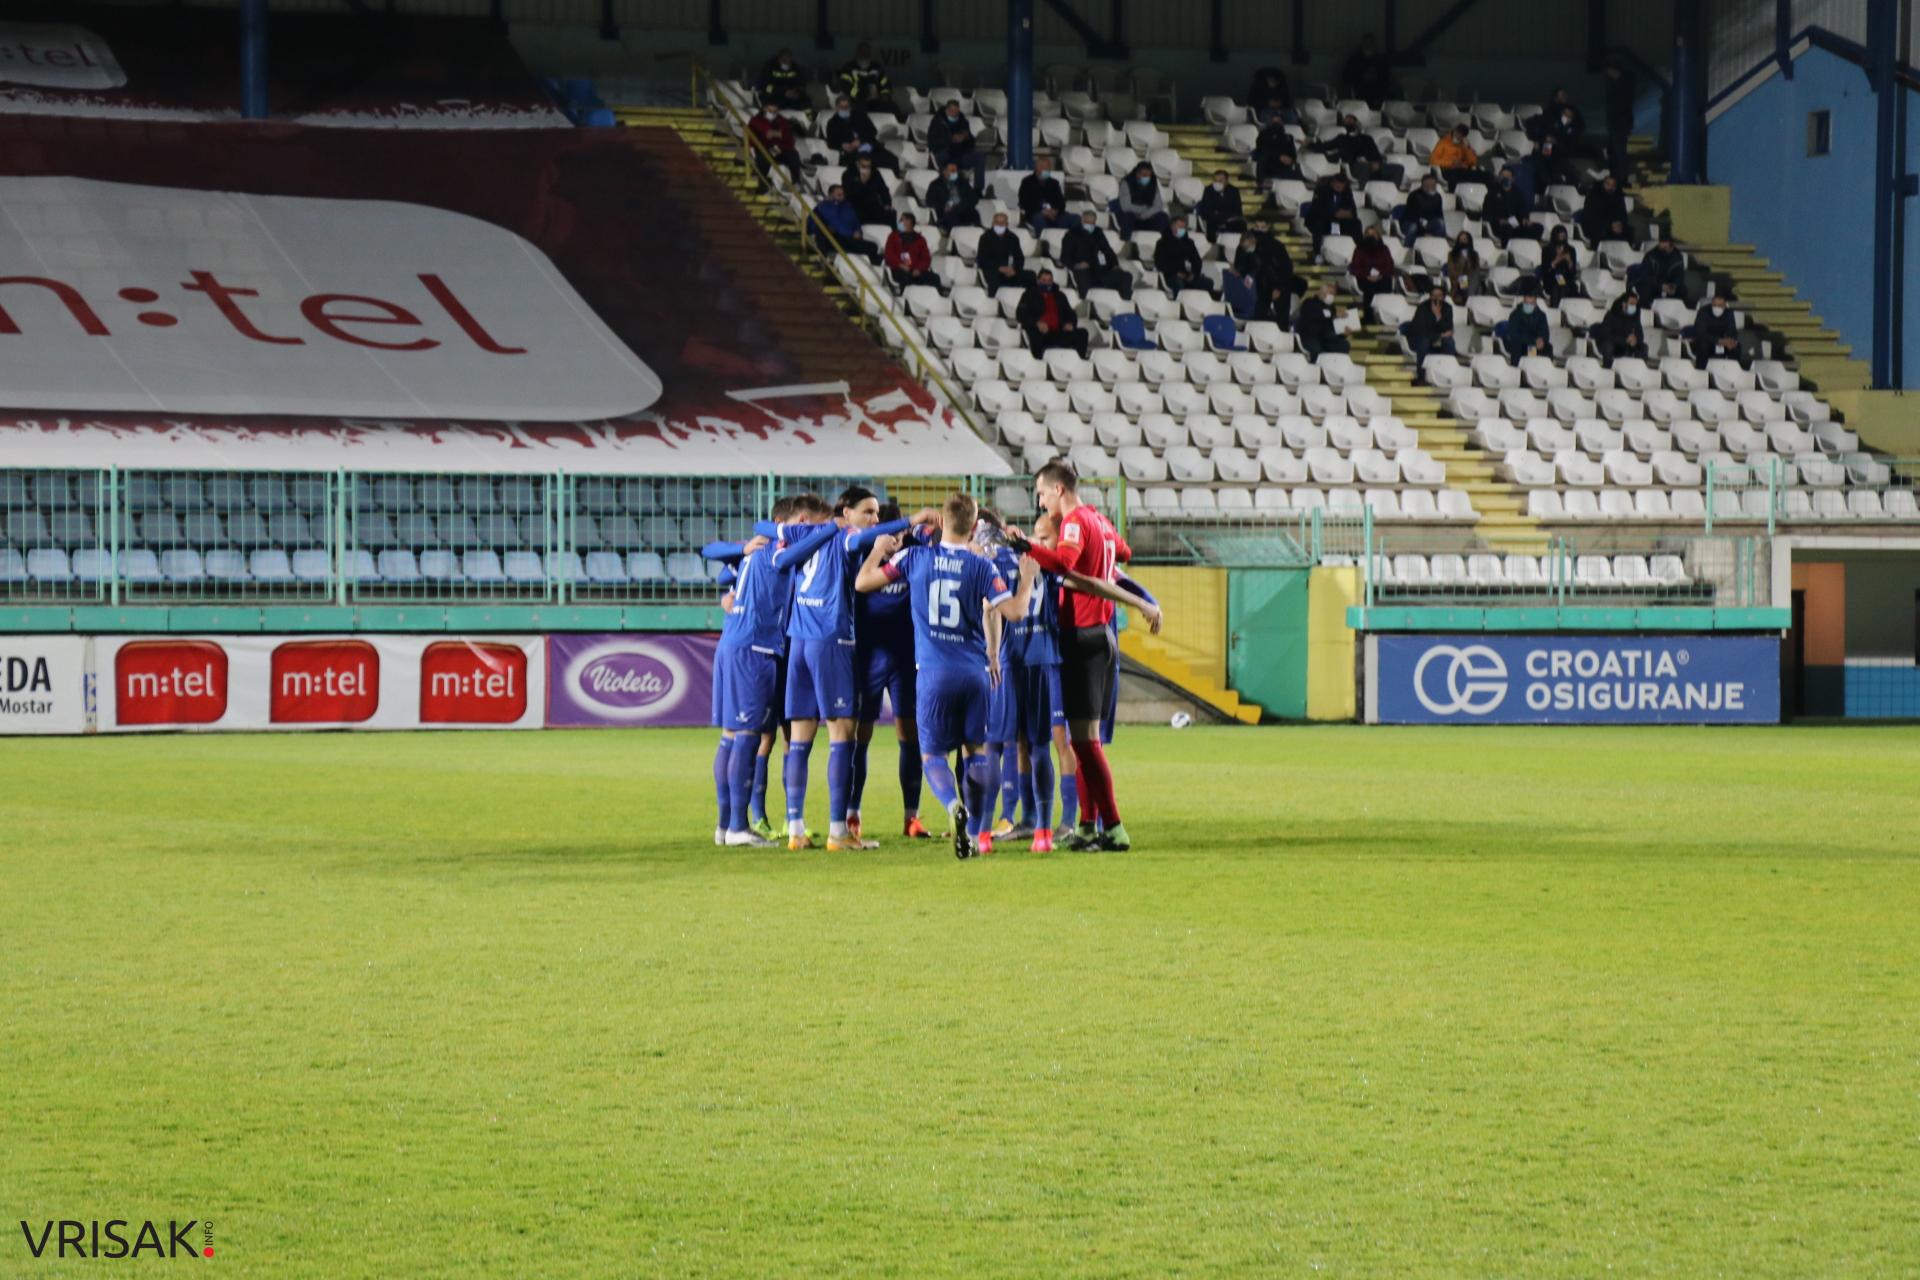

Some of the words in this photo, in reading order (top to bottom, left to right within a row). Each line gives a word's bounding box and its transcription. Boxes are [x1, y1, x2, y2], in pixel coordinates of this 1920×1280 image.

[880, 48, 911, 65] VIP
[928, 578, 961, 629] 15
[0, 656, 52, 692] DA
[127, 662, 215, 698] m:tel
[282, 662, 367, 697] m:tel
[431, 665, 515, 698] m:tel
[590, 665, 662, 693] Violeta
[1525, 682, 1745, 711] OSIGURANJE
